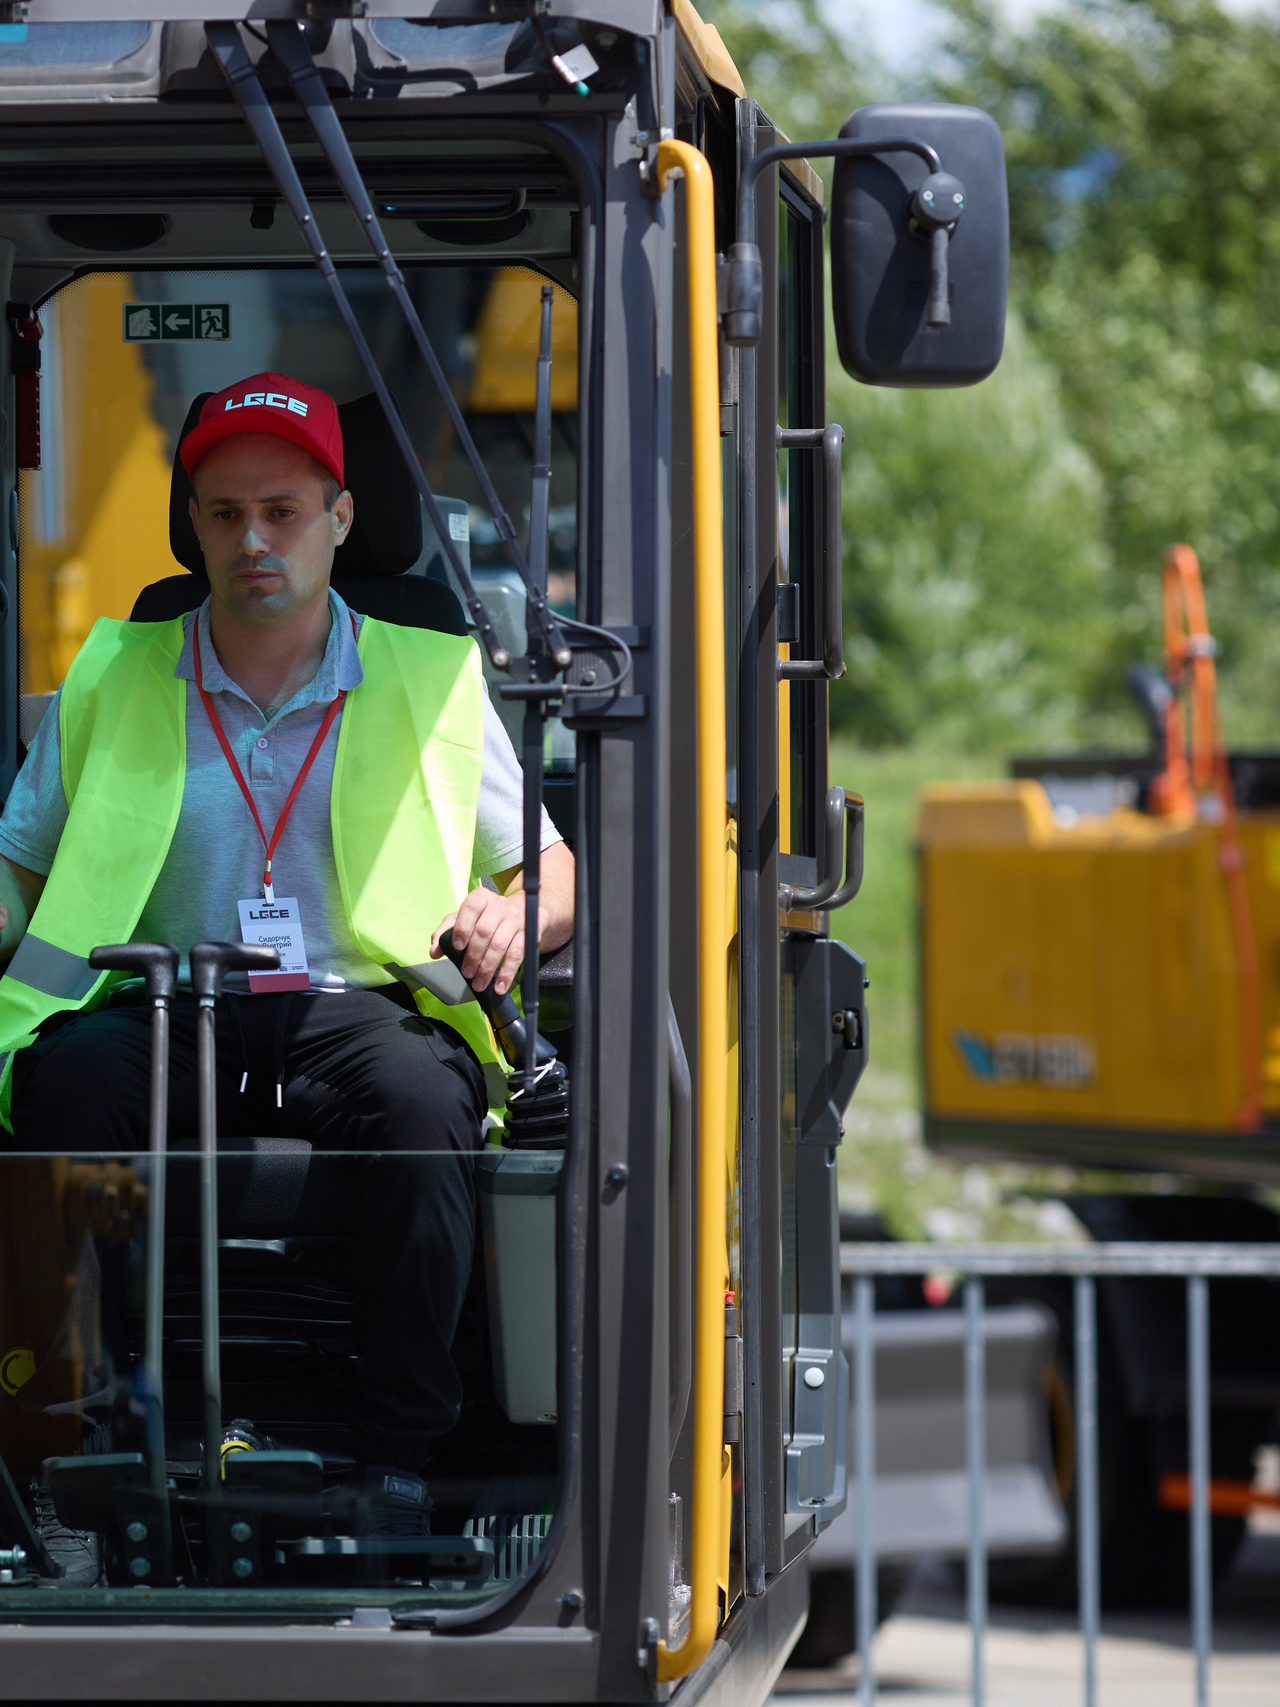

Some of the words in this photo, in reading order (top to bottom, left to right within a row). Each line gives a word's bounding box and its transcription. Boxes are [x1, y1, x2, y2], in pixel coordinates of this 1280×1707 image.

[225, 393, 308, 417] LGCE
[249, 909, 290, 920] LGCE
[258, 935, 291, 943] Сидорчук
